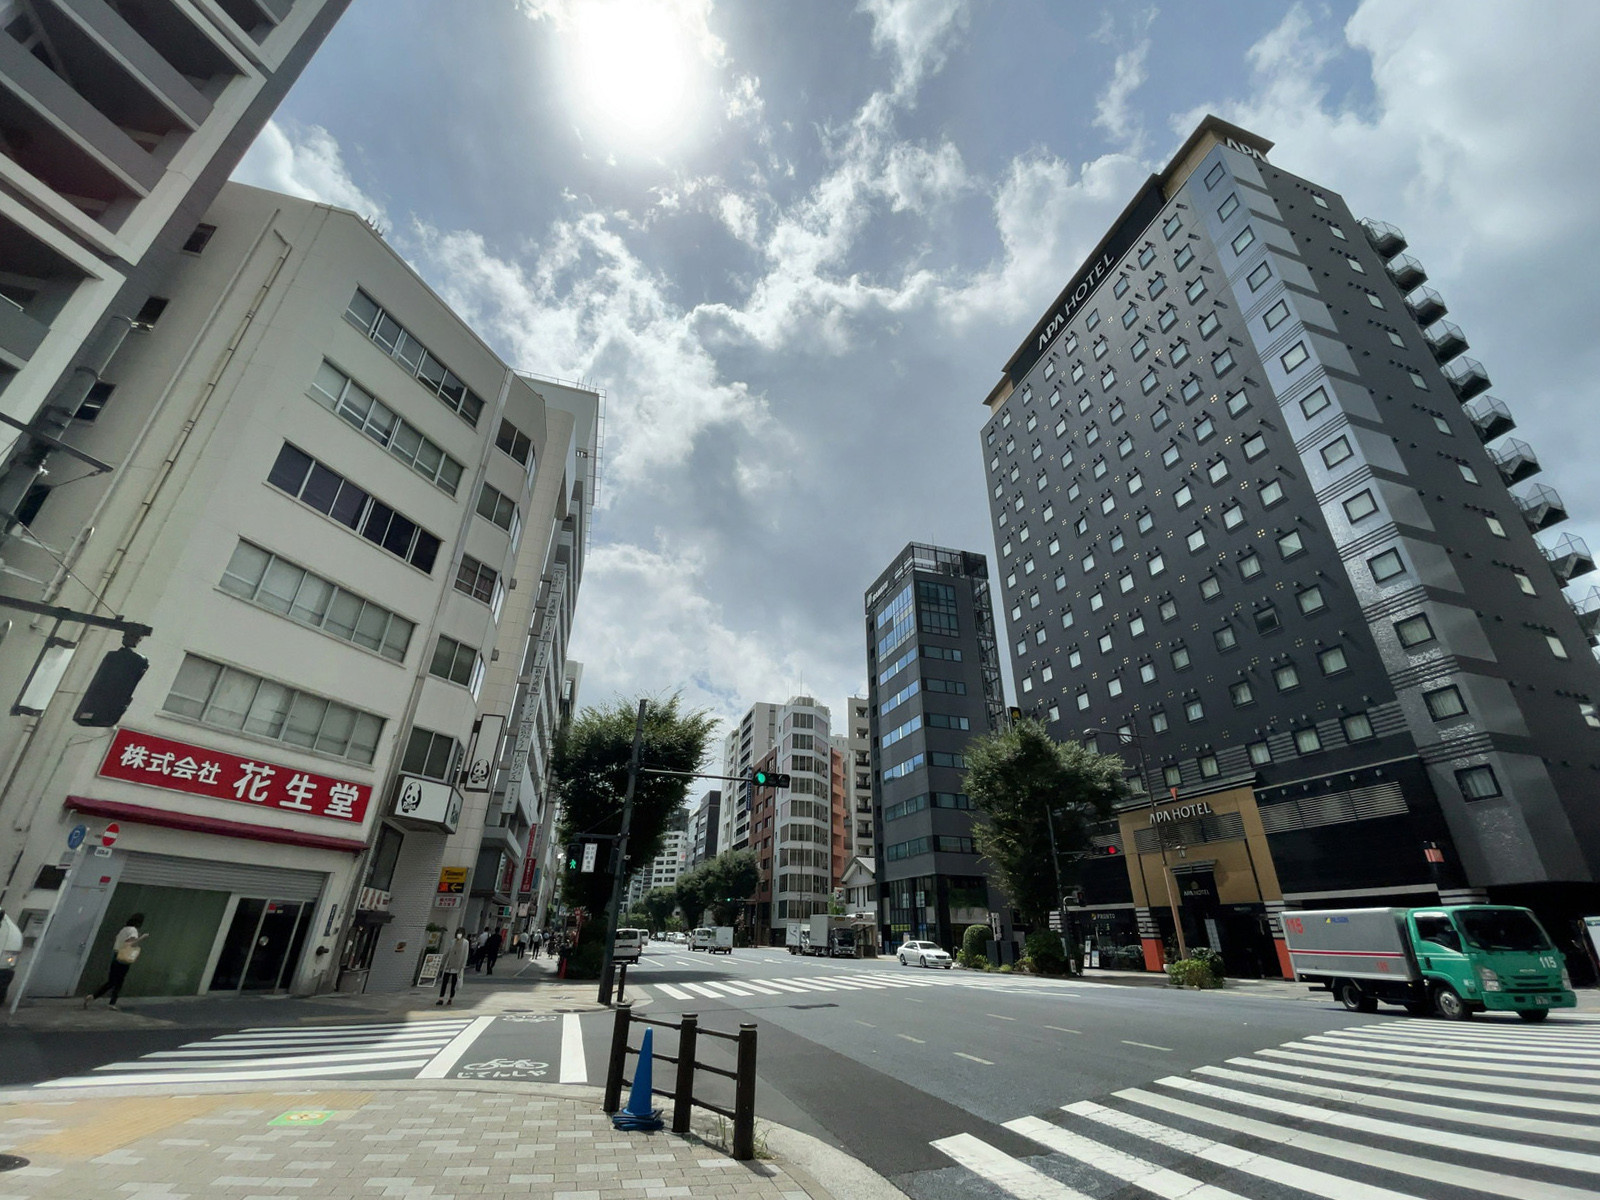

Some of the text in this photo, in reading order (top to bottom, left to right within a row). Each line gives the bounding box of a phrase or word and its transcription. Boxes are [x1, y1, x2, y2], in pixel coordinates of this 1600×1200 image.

[1226, 137, 1269, 164] APA
[1037, 253, 1115, 351] APA HOTEL
[120, 743, 359, 819] 株式会社 花生堂
[1149, 802, 1212, 825] APA HOTEL
[1285, 917, 1304, 935] 115
[1539, 956, 1557, 969] 115
